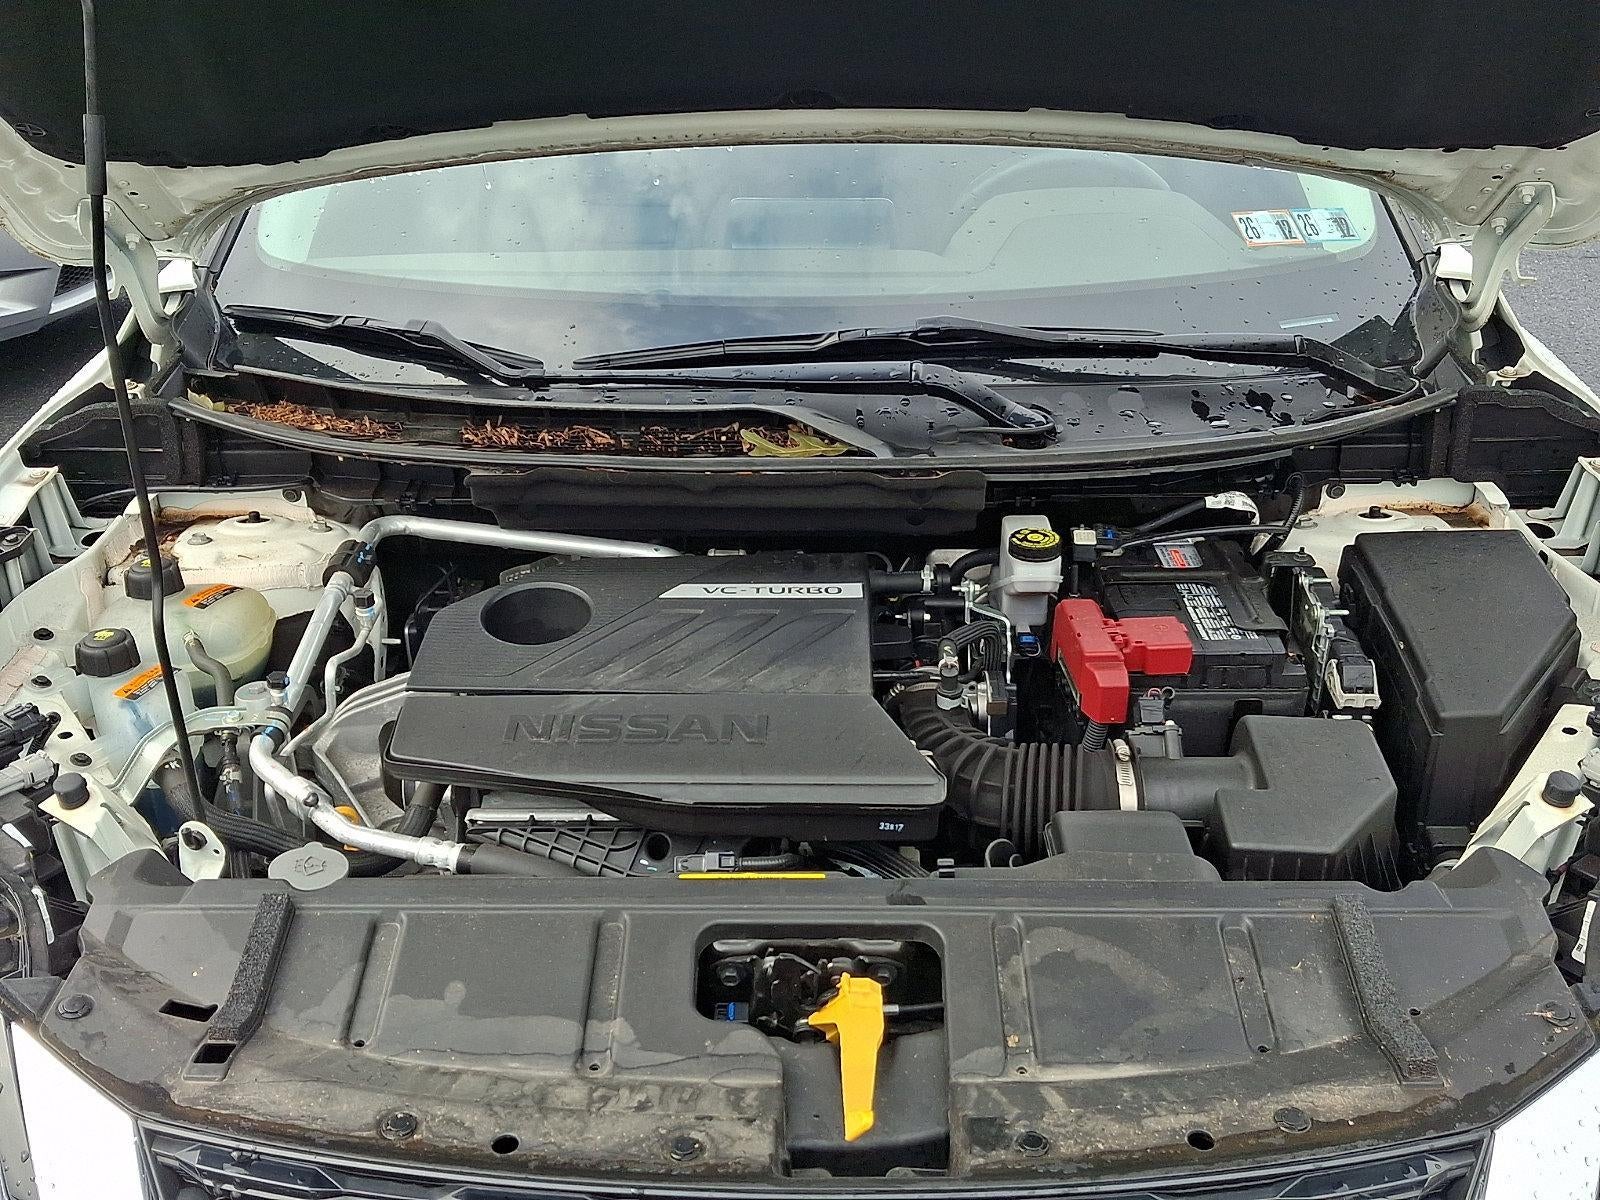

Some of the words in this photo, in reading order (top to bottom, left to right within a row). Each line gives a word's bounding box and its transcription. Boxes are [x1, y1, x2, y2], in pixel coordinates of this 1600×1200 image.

[1239, 216, 1261, 240] 26
[1297, 213, 1320, 237] 26
[702, 585, 843, 595] VC-TURBO
[503, 714, 769, 744] NISSAN
